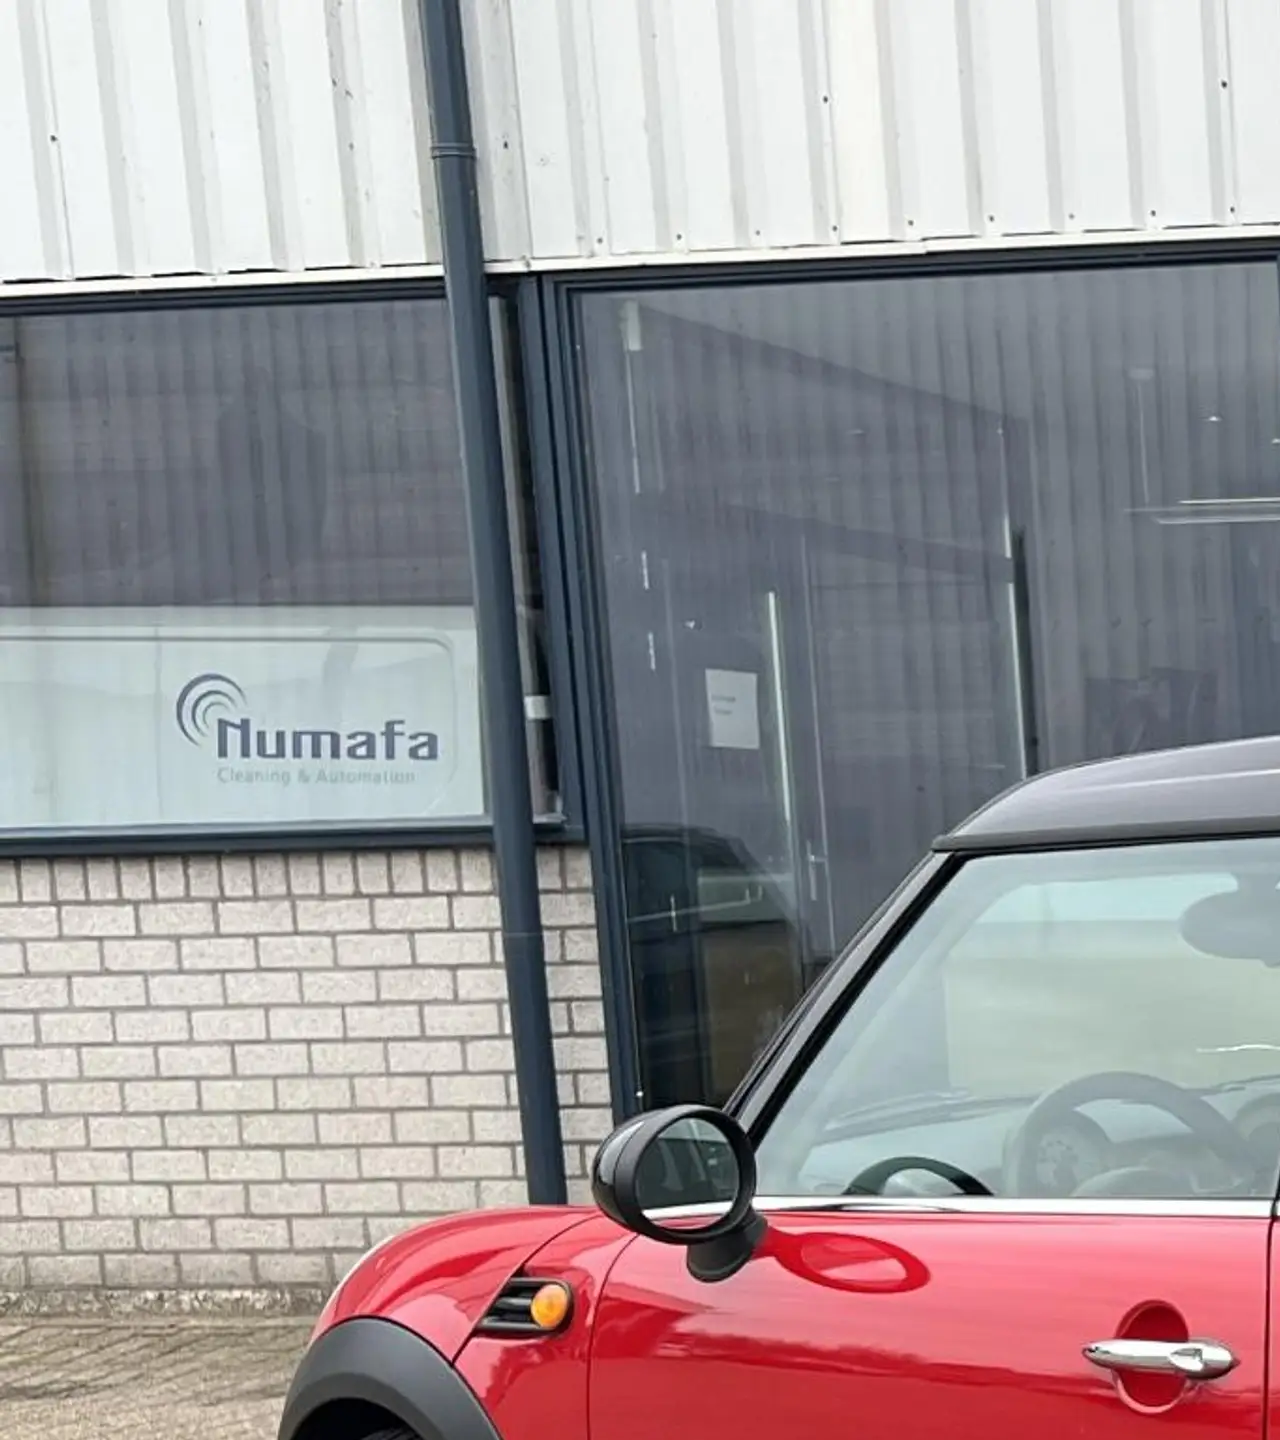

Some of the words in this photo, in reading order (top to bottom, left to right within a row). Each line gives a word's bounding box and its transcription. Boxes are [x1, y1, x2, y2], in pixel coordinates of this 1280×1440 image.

[216, 717, 439, 761] Numafa
[216, 767, 291, 787] Cleaning
[315, 767, 416, 785] Automation
